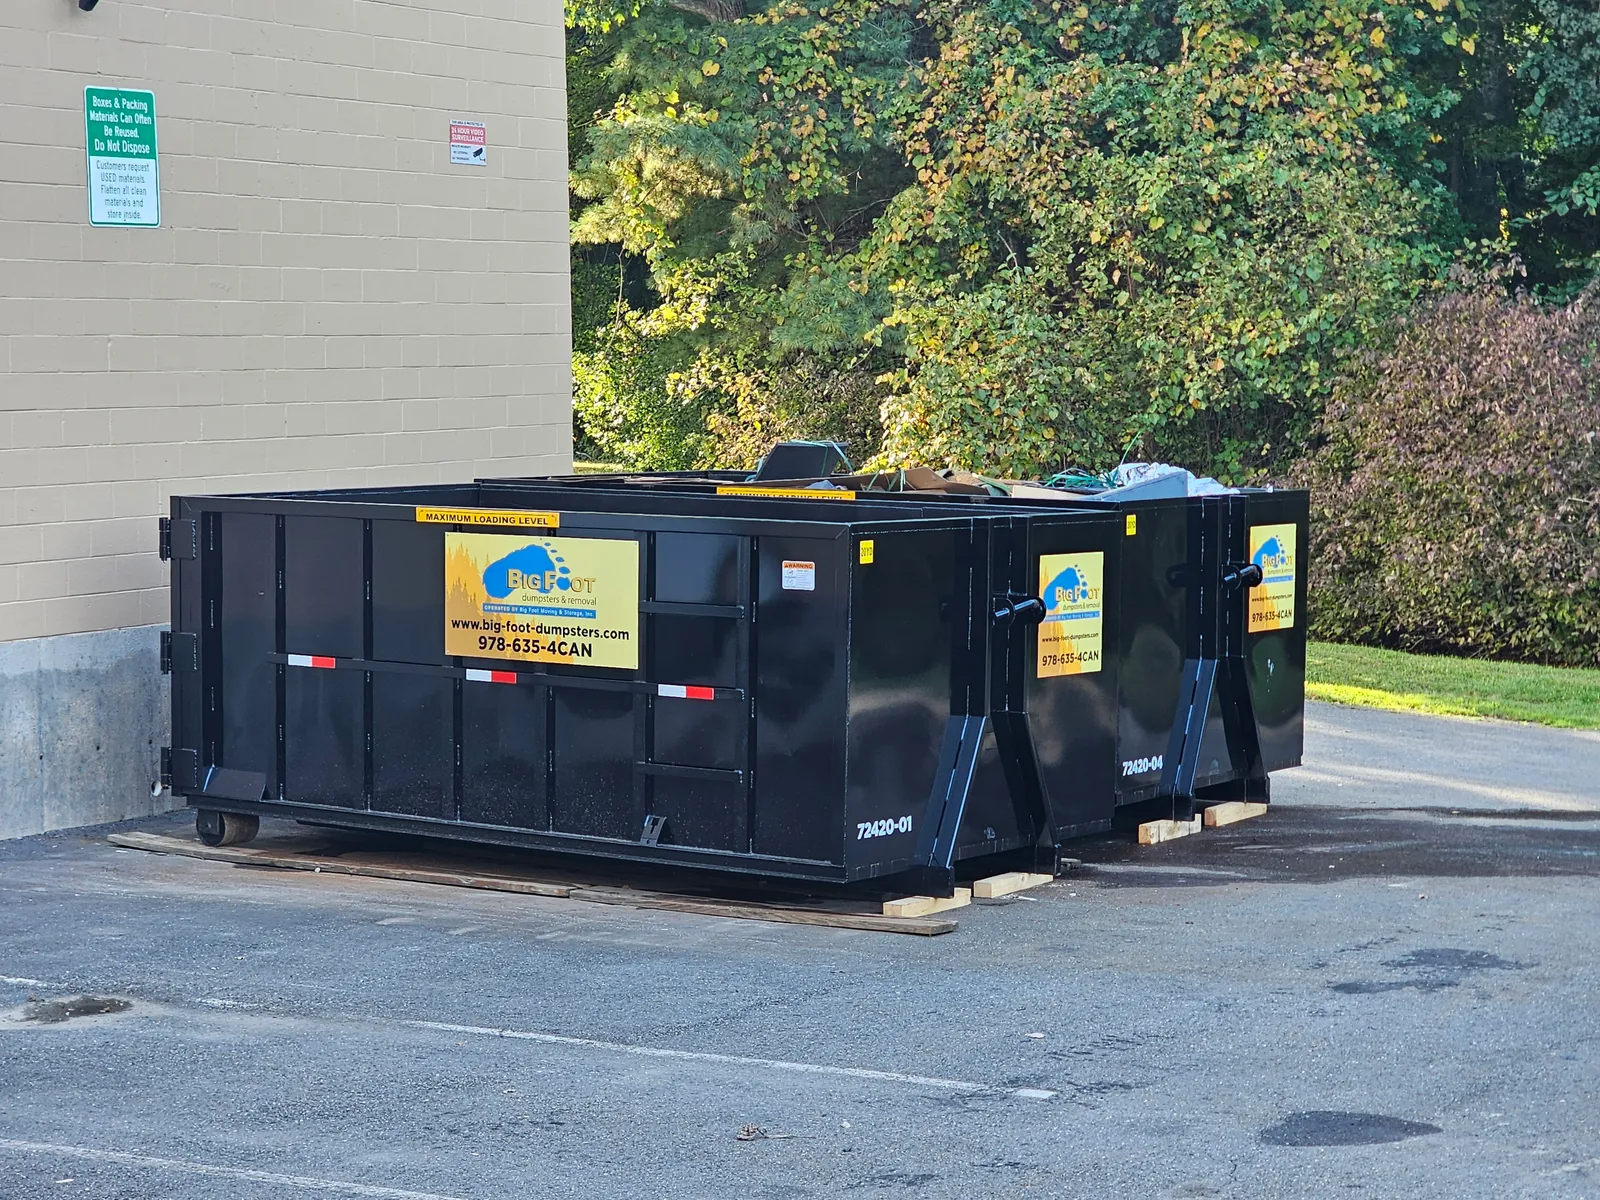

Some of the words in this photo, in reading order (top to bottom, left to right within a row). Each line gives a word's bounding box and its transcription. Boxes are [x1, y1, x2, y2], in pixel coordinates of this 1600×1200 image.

[93, 96, 112, 108] Boxes
[114, 98, 121, 109] &
[122, 99, 148, 114] Packing
[90, 110, 119, 123] Materials
[121, 112, 133, 124] Can
[135, 114, 152, 125] Often
[104, 125, 113, 137] Be
[115, 126, 140, 138] Reused.
[95, 139, 105, 152] Do
[107, 140, 121, 153] Not
[123, 141, 150, 156] Dispose
[97, 160, 127, 171] Customers
[129, 163, 150, 173] request
[101, 173, 117, 183] USED
[101, 185, 121, 195] Flatten
[132, 188, 147, 197] clean
[105, 198, 131, 208] materials
[133, 199, 144, 208] and
[425, 513, 471, 523] MAXIMUM
[474, 515, 516, 525] LOADING
[519, 517, 549, 526] LEVEL
[521, 593, 560, 604] dumpsters
[560, 595, 567, 604] &
[568, 596, 597, 606] removal
[484, 604, 511, 612] OPERATED
[1251, 608, 1293, 623] 978-635-4CAN
[451, 618, 630, 641] www.big-foot-dumpsters.com
[1041, 632, 1099, 643] www.big-foot-dumpsters.com
[478, 635, 593, 658] 978-635-4CAN
[1042, 649, 1099, 667] 978-635-4CAN
[1122, 754, 1163, 777] 72420-04
[857, 815, 912, 840] 72420-01
